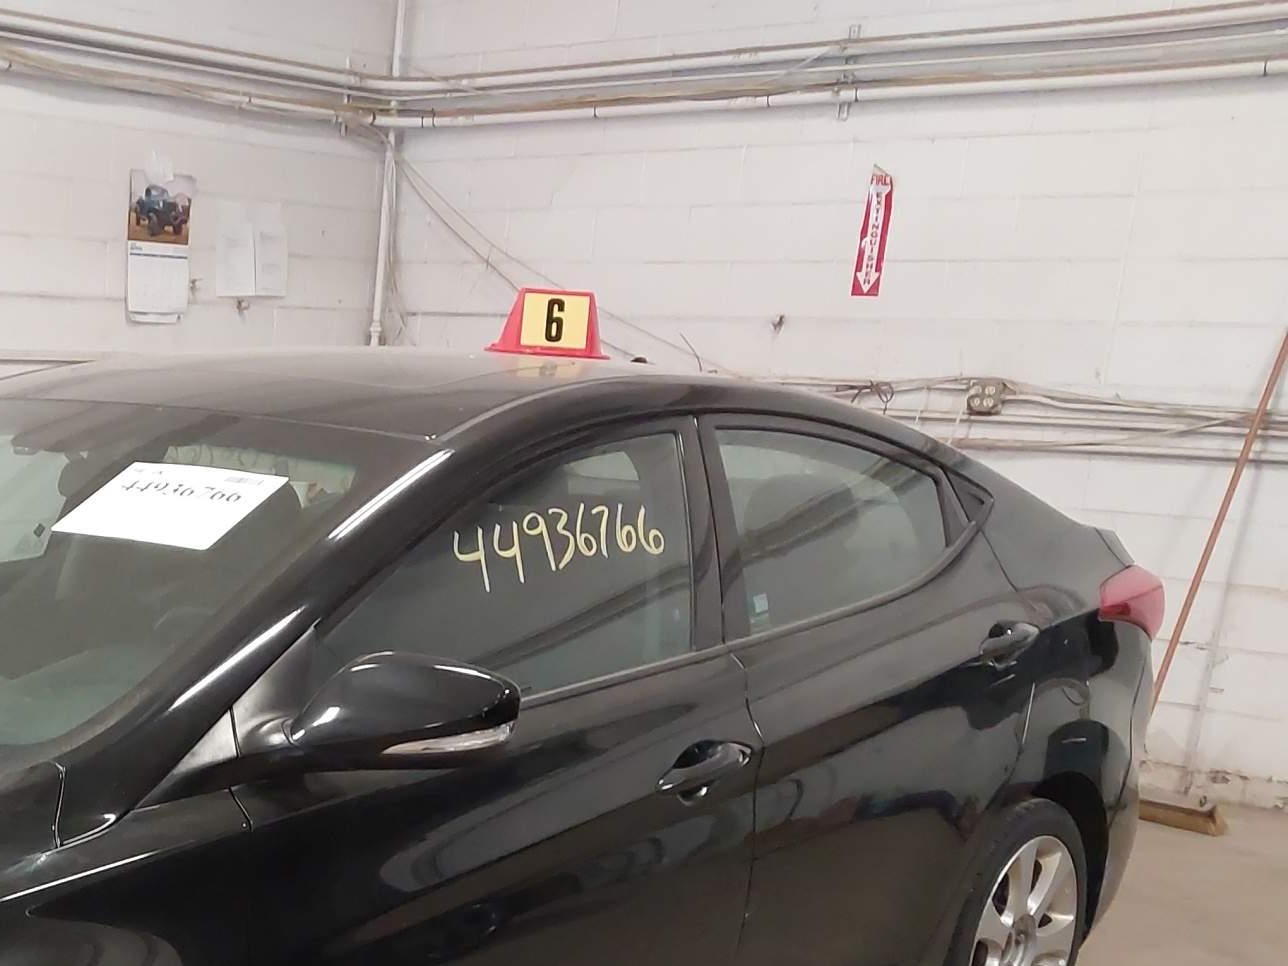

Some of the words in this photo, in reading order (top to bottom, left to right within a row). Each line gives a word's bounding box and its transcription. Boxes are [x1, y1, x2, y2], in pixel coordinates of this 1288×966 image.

[871, 174, 890, 186] FIRE
[545, 297, 565, 343] 6
[452, 502, 665, 593] 44936766
